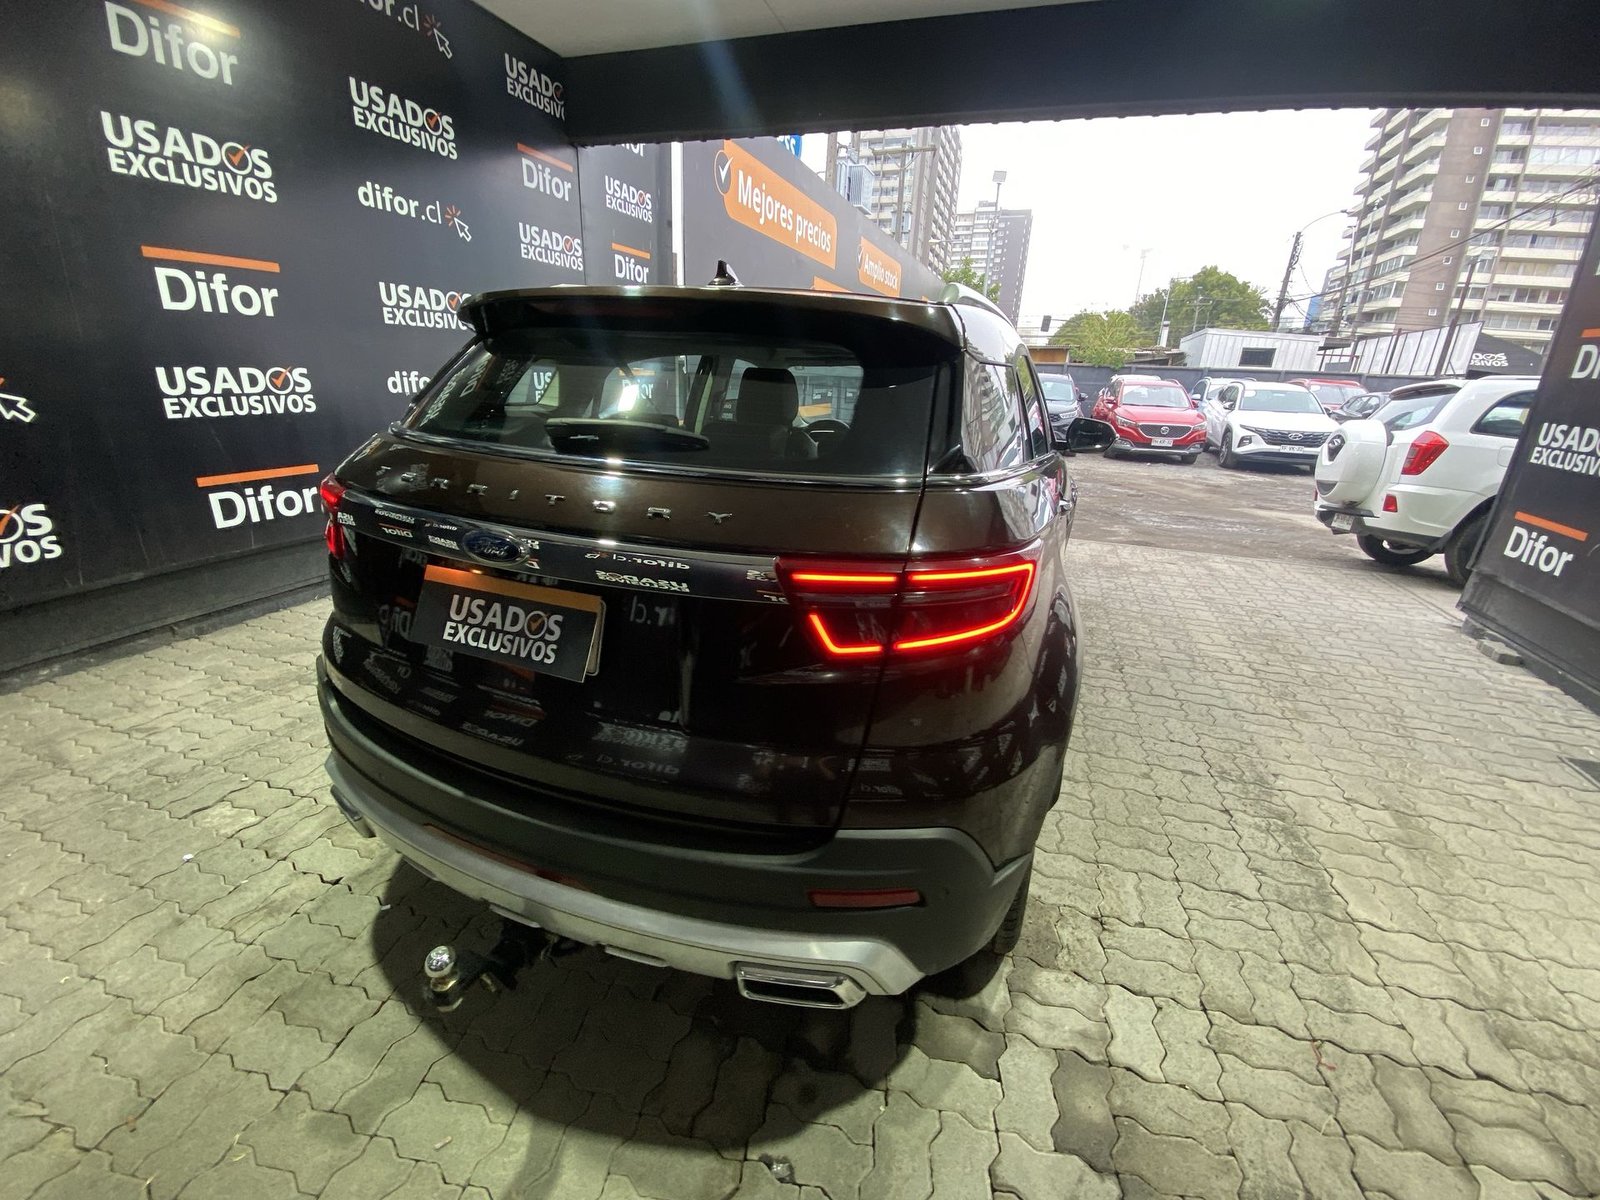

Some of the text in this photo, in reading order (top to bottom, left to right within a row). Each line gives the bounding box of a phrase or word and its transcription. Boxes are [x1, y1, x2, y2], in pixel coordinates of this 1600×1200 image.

[104, 1, 239, 86] Difor
[349, 76, 456, 141] USADOS
[100, 110, 273, 180] USADOS
[353, 105, 458, 160] EXCLUSIVOS
[106, 147, 279, 204] EXCLUSIVOS
[521, 157, 572, 202] Difor
[604, 174, 653, 211] USADOS
[357, 181, 442, 225] difor.cl
[605, 194, 653, 224] EXCLUSIVOS
[737, 169, 832, 253] Mejores precios
[518, 222, 582, 257] USADOS
[520, 244, 584, 272] EXCLUSIVOS
[154, 266, 279, 317] Difor
[614, 254, 650, 284] Difor
[863, 253, 899, 291] Amplio stock
[155, 366, 313, 396] USADOS
[162, 394, 318, 419] EXCLUSIVOS
[208, 484, 319, 530] Difor
[1503, 525, 1574, 578] Difor
[449, 593, 564, 642] USADOS
[442, 621, 558, 665] EXCLUSIVOS
